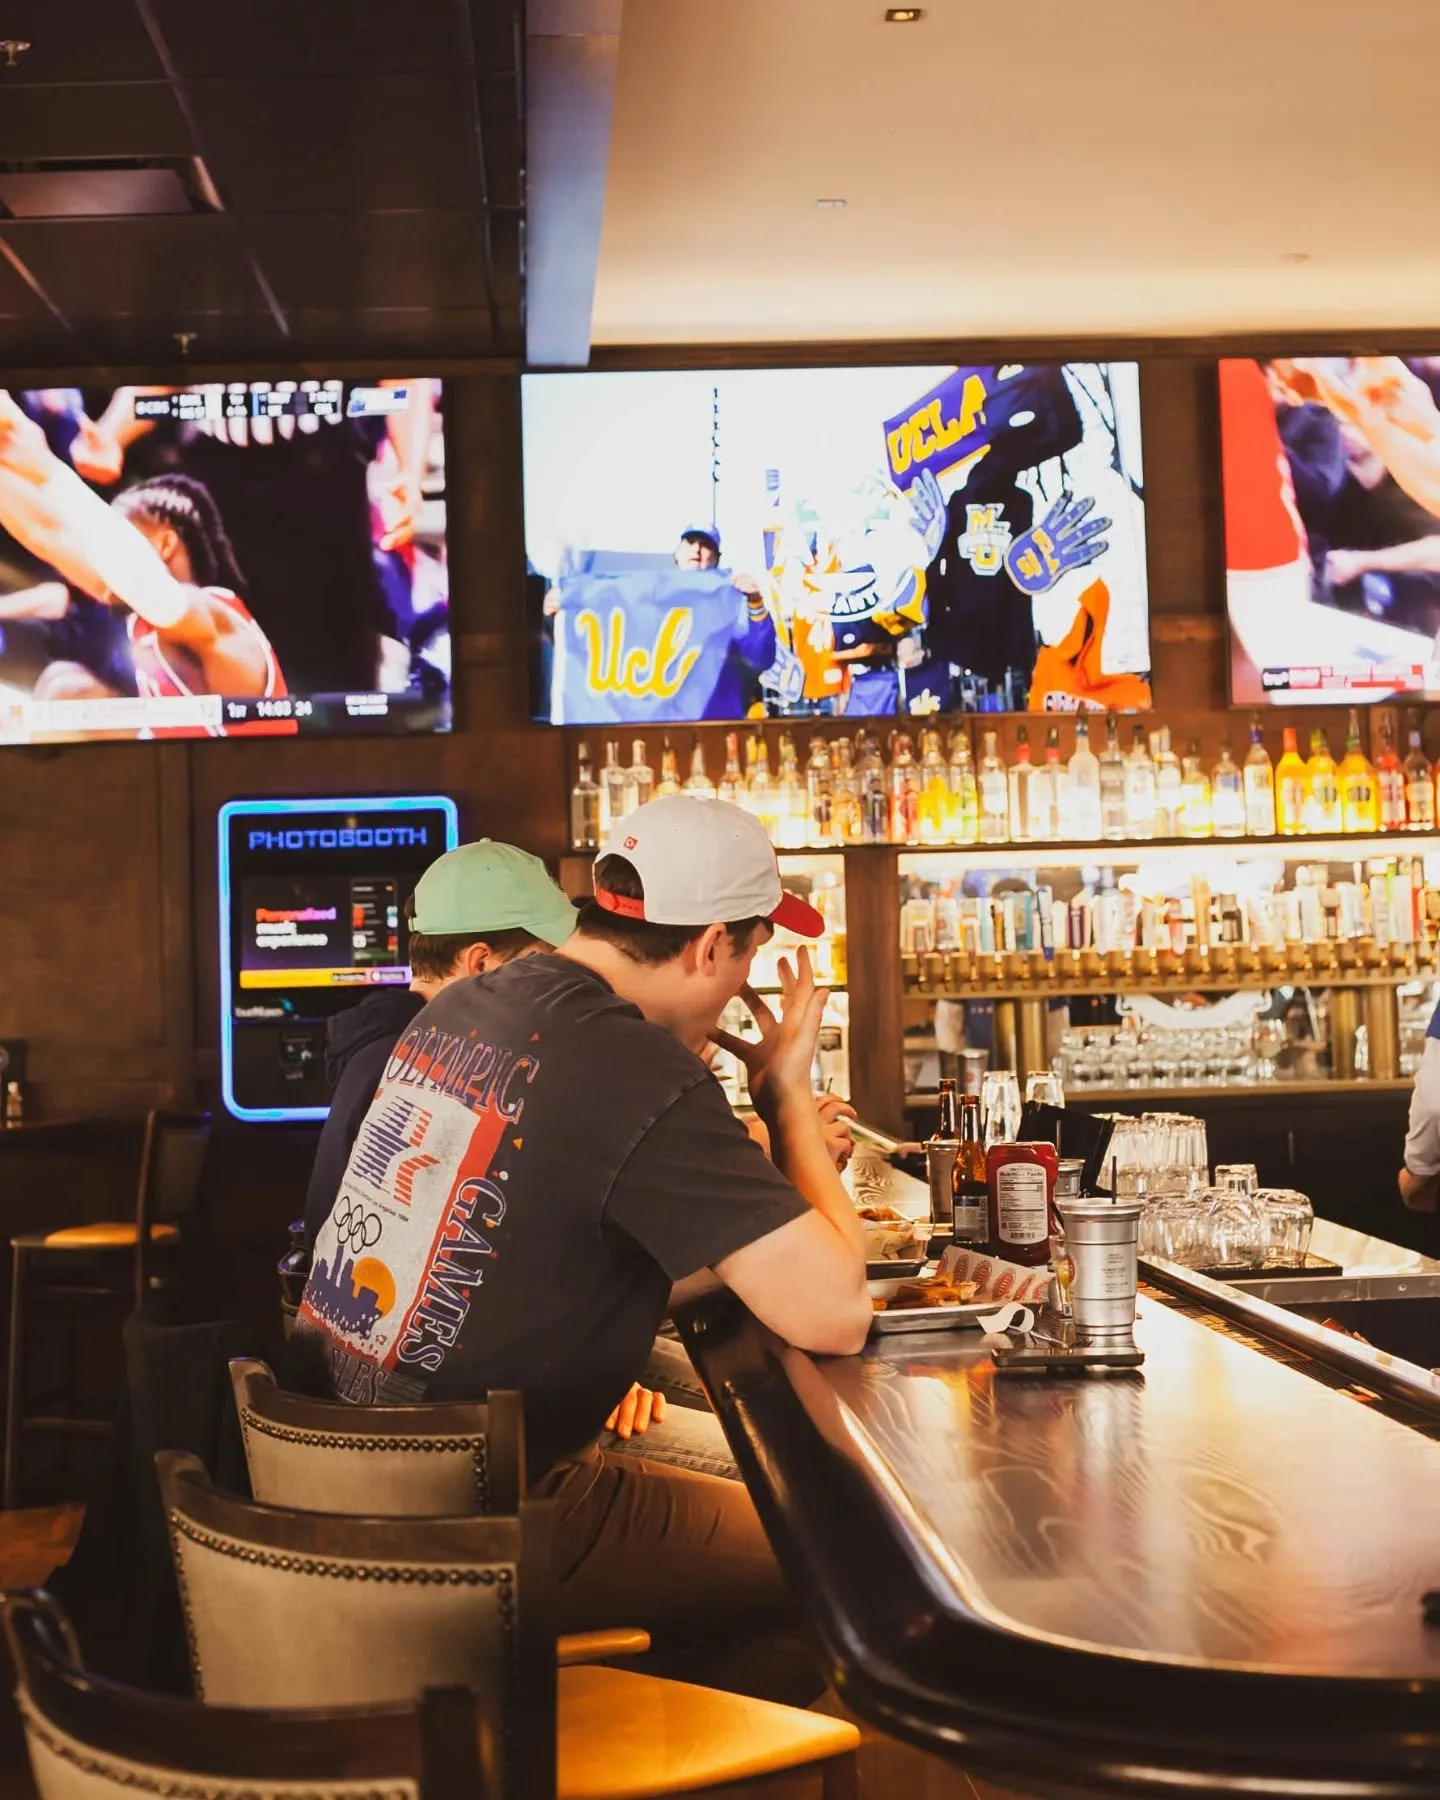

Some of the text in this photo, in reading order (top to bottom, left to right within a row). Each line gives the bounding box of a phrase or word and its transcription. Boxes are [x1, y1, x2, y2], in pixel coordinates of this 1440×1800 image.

[887, 374, 987, 474] UCLA
[248, 827, 427, 850] PHOTOBOOTH
[385, 1027, 540, 1124] OLYMPIC
[396, 1176, 508, 1372] GAMES
